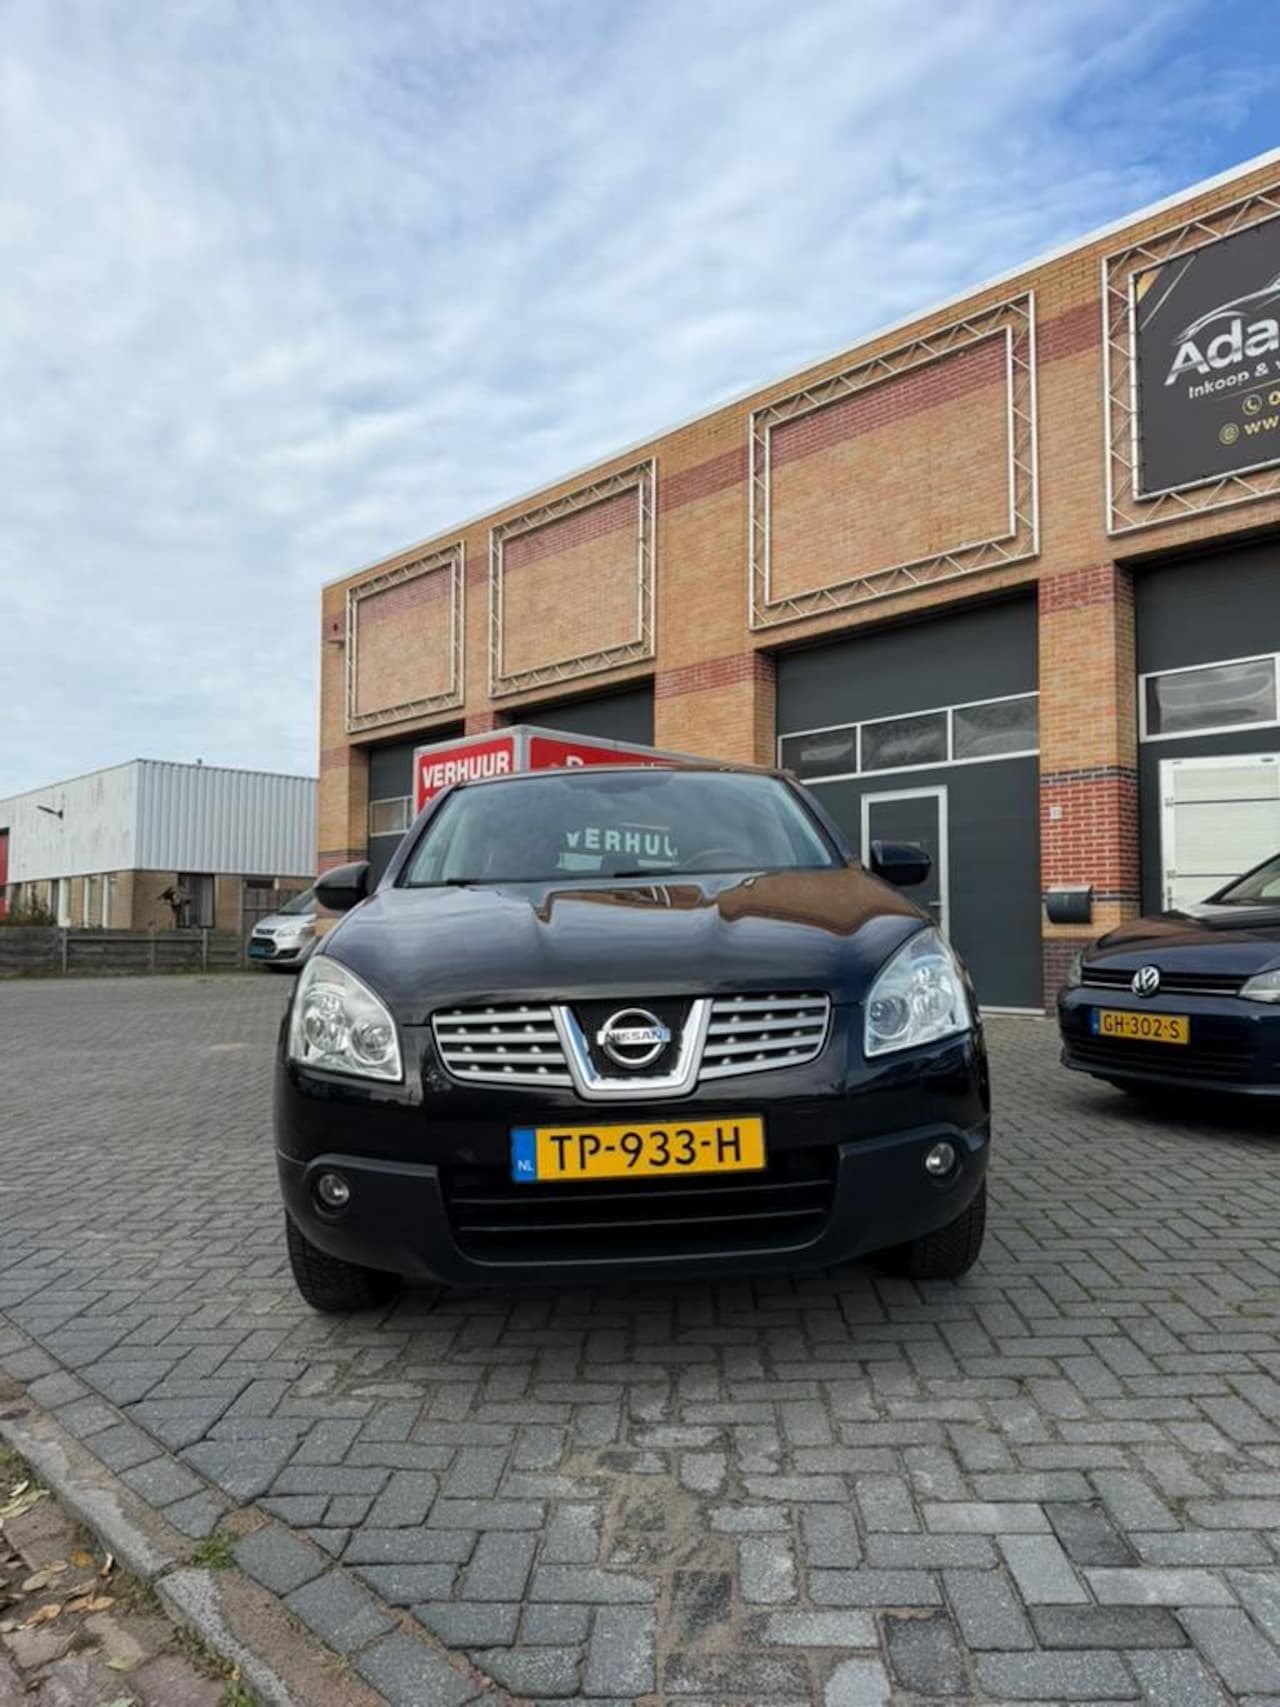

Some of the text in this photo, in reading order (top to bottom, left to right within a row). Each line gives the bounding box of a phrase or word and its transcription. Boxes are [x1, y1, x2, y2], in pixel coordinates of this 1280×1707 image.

[1189, 371, 1249, 398] Inkoop
[1254, 362, 1269, 377] &
[422, 750, 509, 789] VERHUUR
[605, 1030, 663, 1041] NISSAN
[1103, 1013, 1180, 1039] GH-302-S
[549, 1126, 741, 1171] TP-933-H
[517, 1159, 534, 1172] NL
